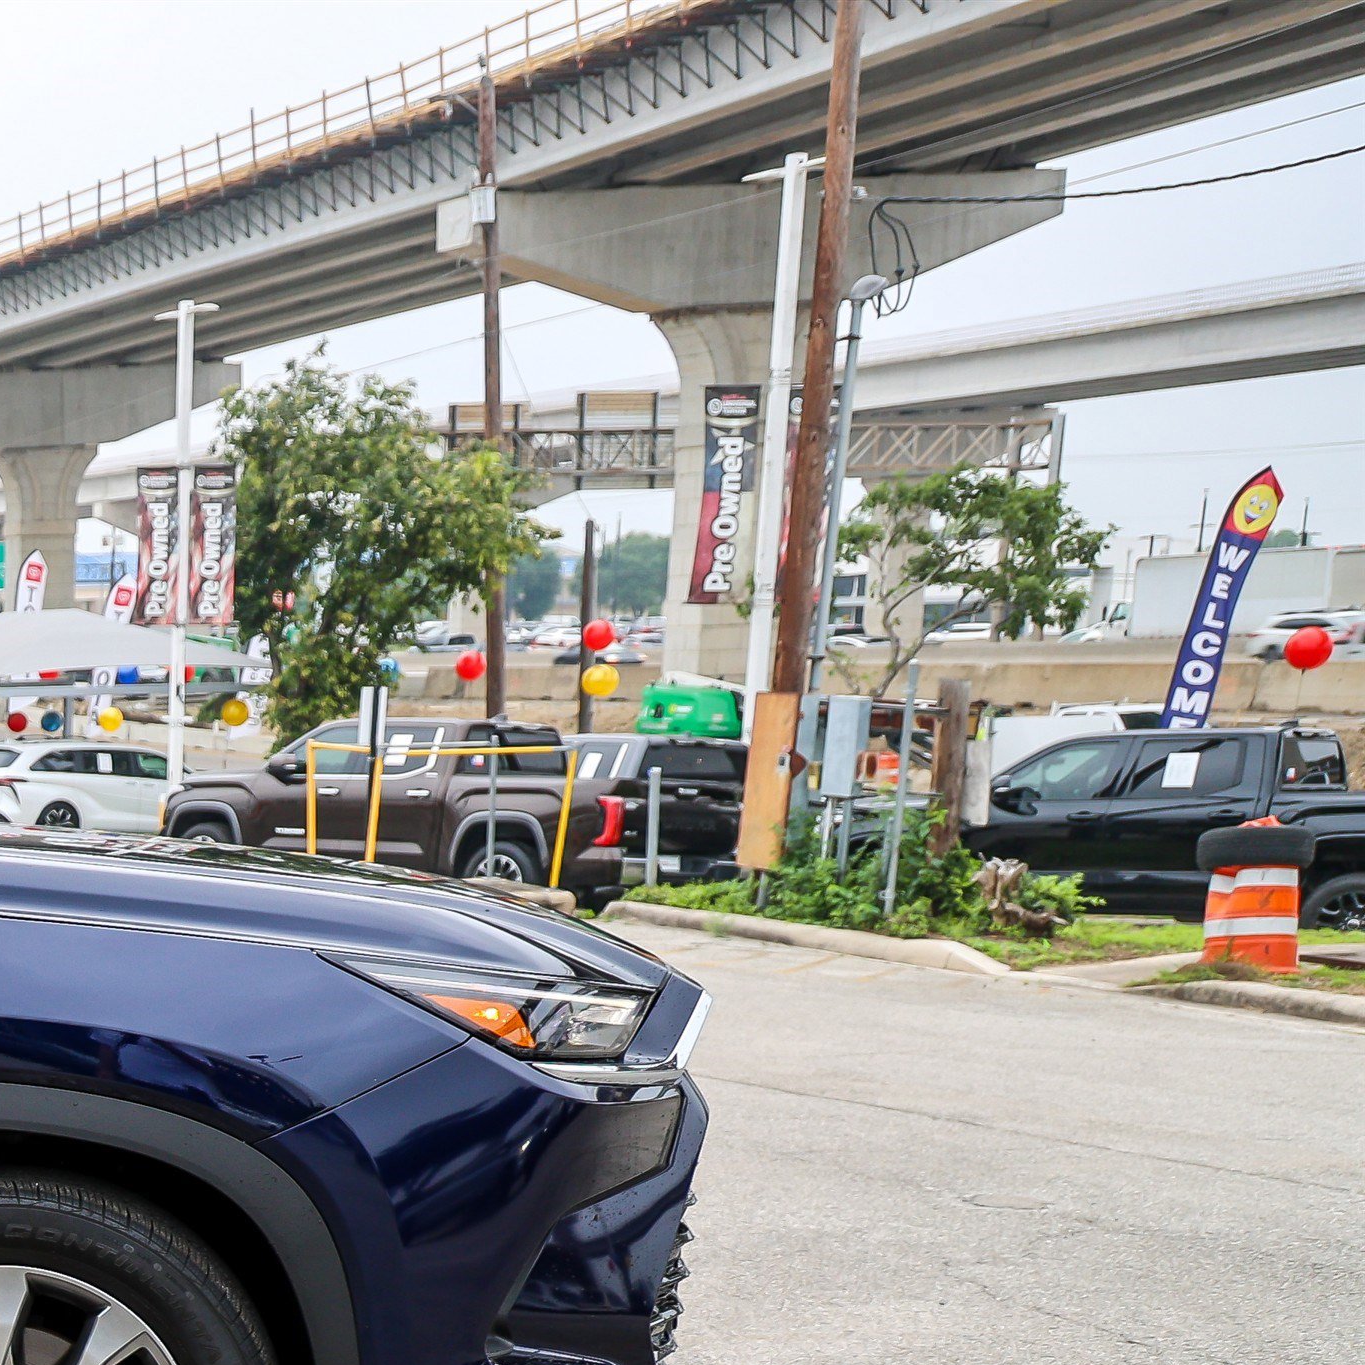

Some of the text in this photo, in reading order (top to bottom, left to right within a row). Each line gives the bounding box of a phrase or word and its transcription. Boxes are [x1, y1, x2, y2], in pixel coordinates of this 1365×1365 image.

[711, 436, 745, 540] Owned
[147, 502, 169, 580] Owned
[199, 502, 224, 580] Owned
[702, 541, 737, 593] Pre
[143, 580, 168, 618] Pre
[197, 580, 221, 618] Pre
